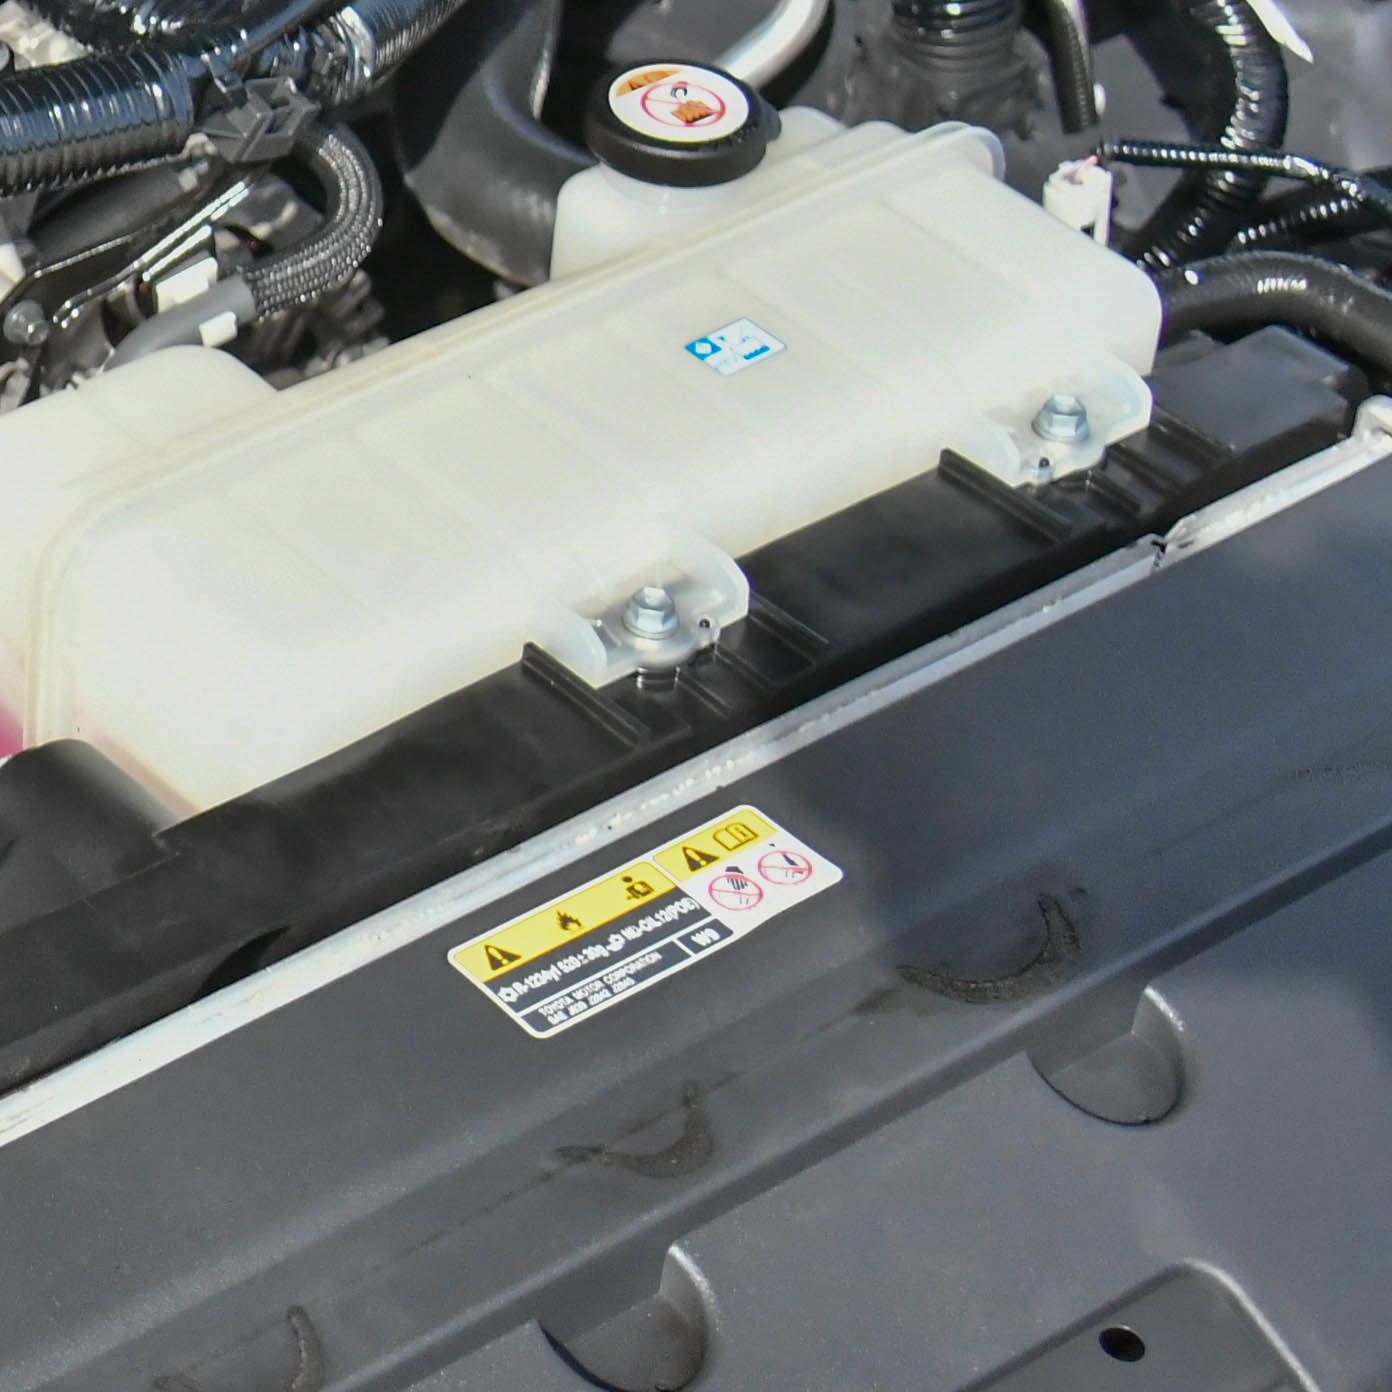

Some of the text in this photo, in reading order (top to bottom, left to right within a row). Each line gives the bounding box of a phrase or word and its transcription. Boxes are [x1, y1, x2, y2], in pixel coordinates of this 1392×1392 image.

[538, 951, 662, 1017] TOYOTA MOTOR CORPORATION
